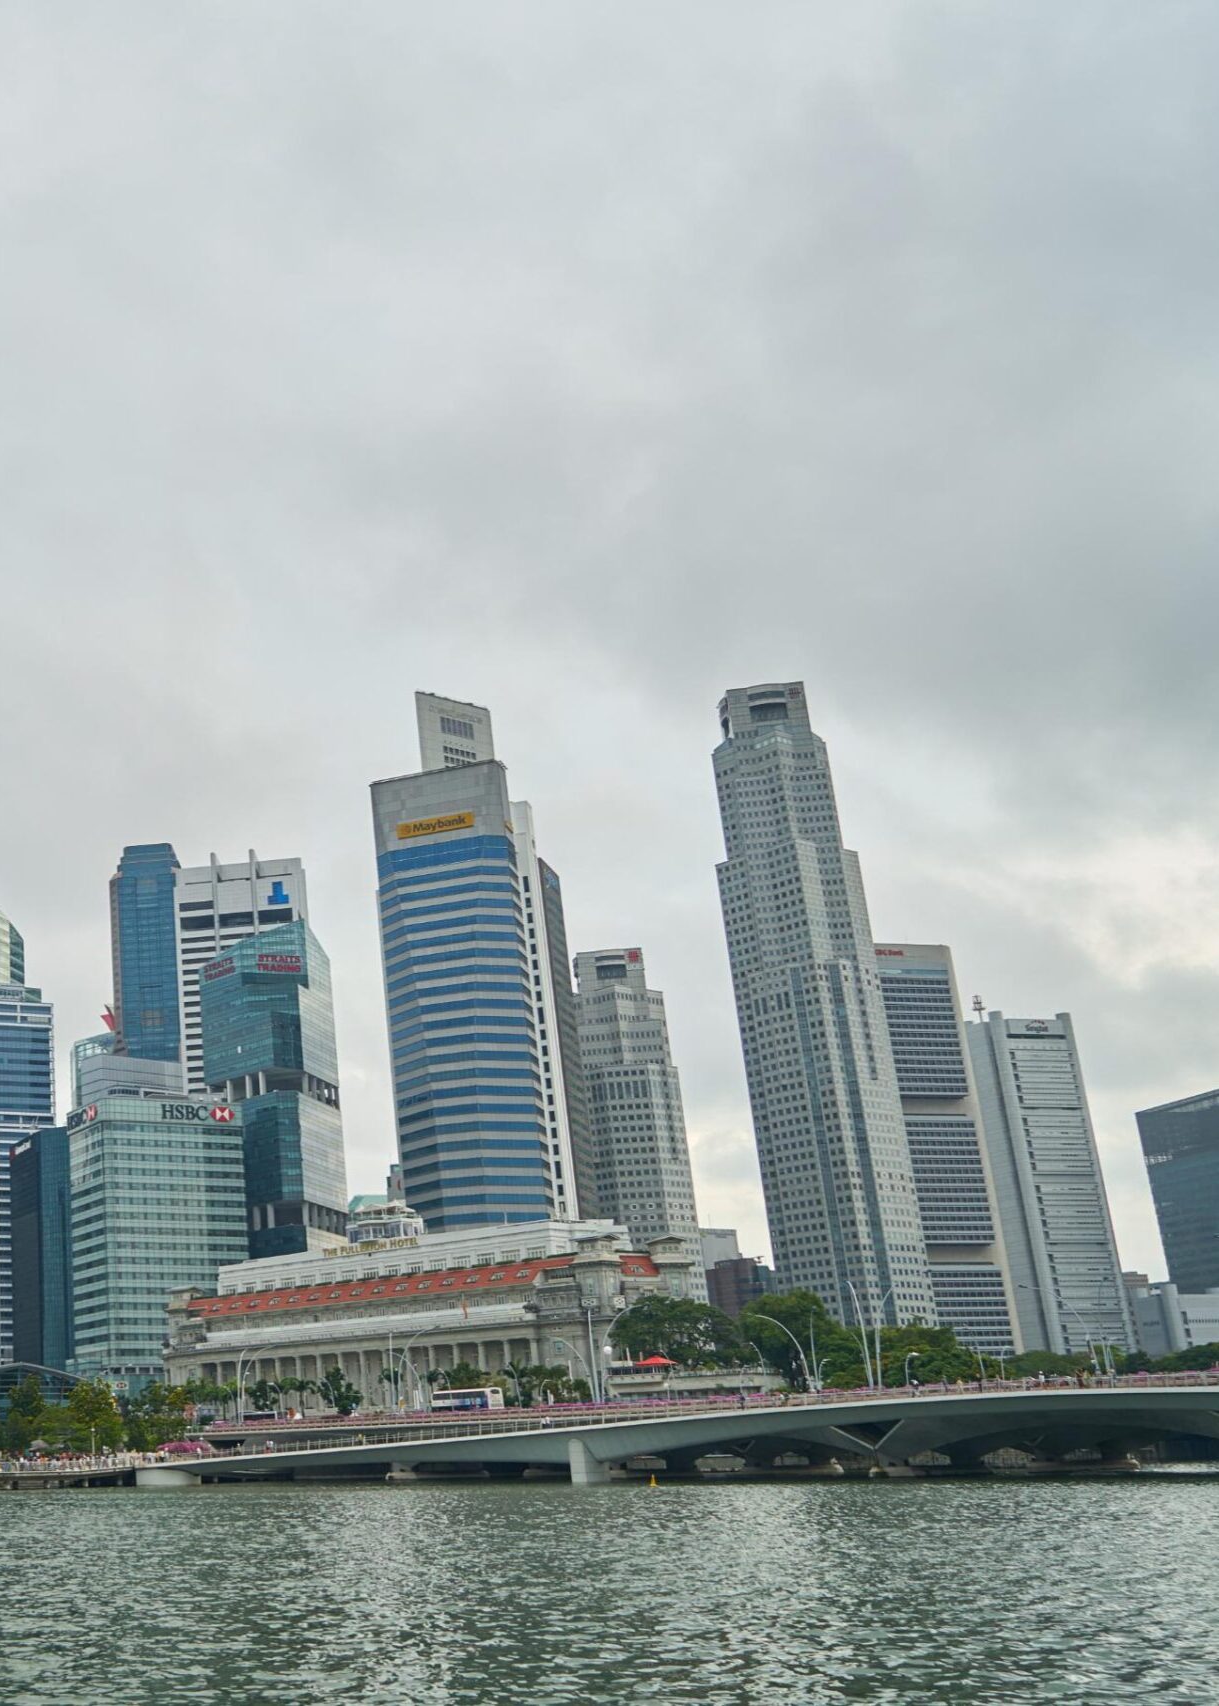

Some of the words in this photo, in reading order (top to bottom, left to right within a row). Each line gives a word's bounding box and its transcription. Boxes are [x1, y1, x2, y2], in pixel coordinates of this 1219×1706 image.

[412, 815, 467, 833] Maybank
[203, 956, 234, 974] STRAITS
[257, 954, 301, 964] STRAITS
[257, 963, 301, 973] TRADING
[161, 1103, 208, 1121] HSBC
[323, 1248, 338, 1258] THE
[340, 1241, 387, 1255] FULLERTON
[389, 1237, 418, 1249] HOTEL
